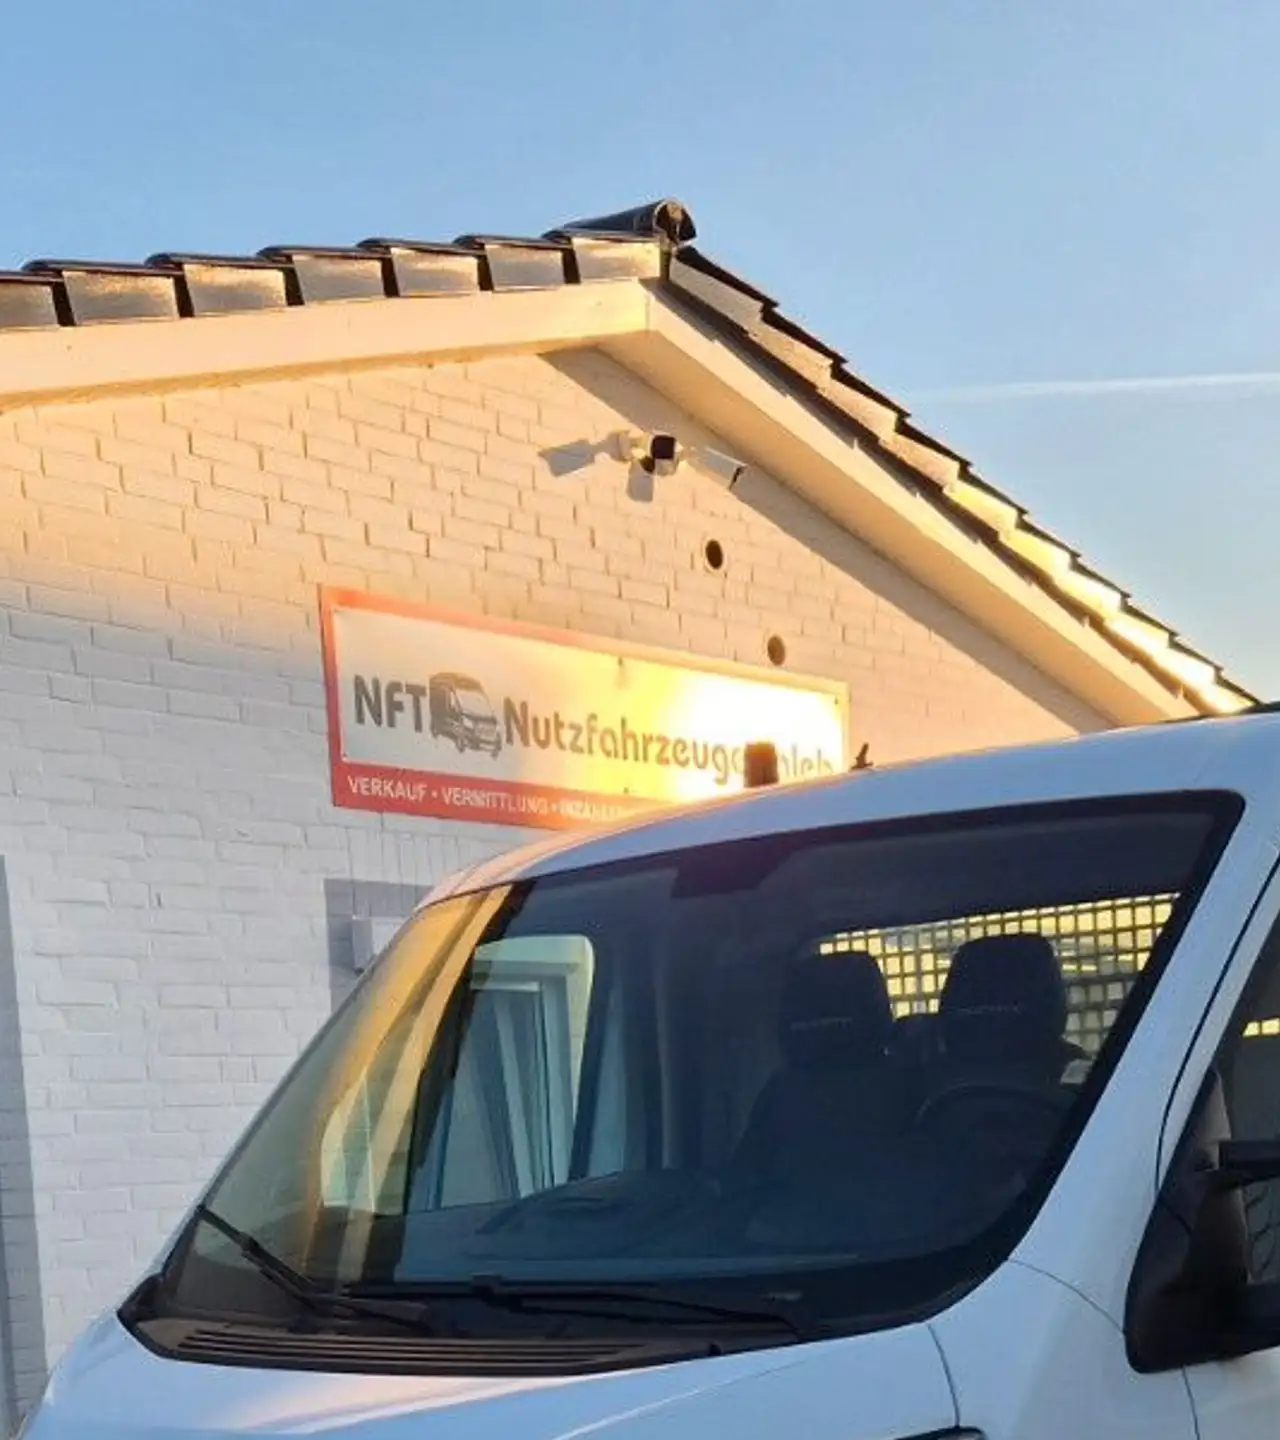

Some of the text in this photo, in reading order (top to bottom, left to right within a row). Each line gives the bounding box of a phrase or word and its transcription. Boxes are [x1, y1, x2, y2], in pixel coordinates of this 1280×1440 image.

[353, 675, 427, 734] NFT
[348, 775, 427, 801] VERKAUF
[441, 787, 549, 816] VERMITTLUNG
